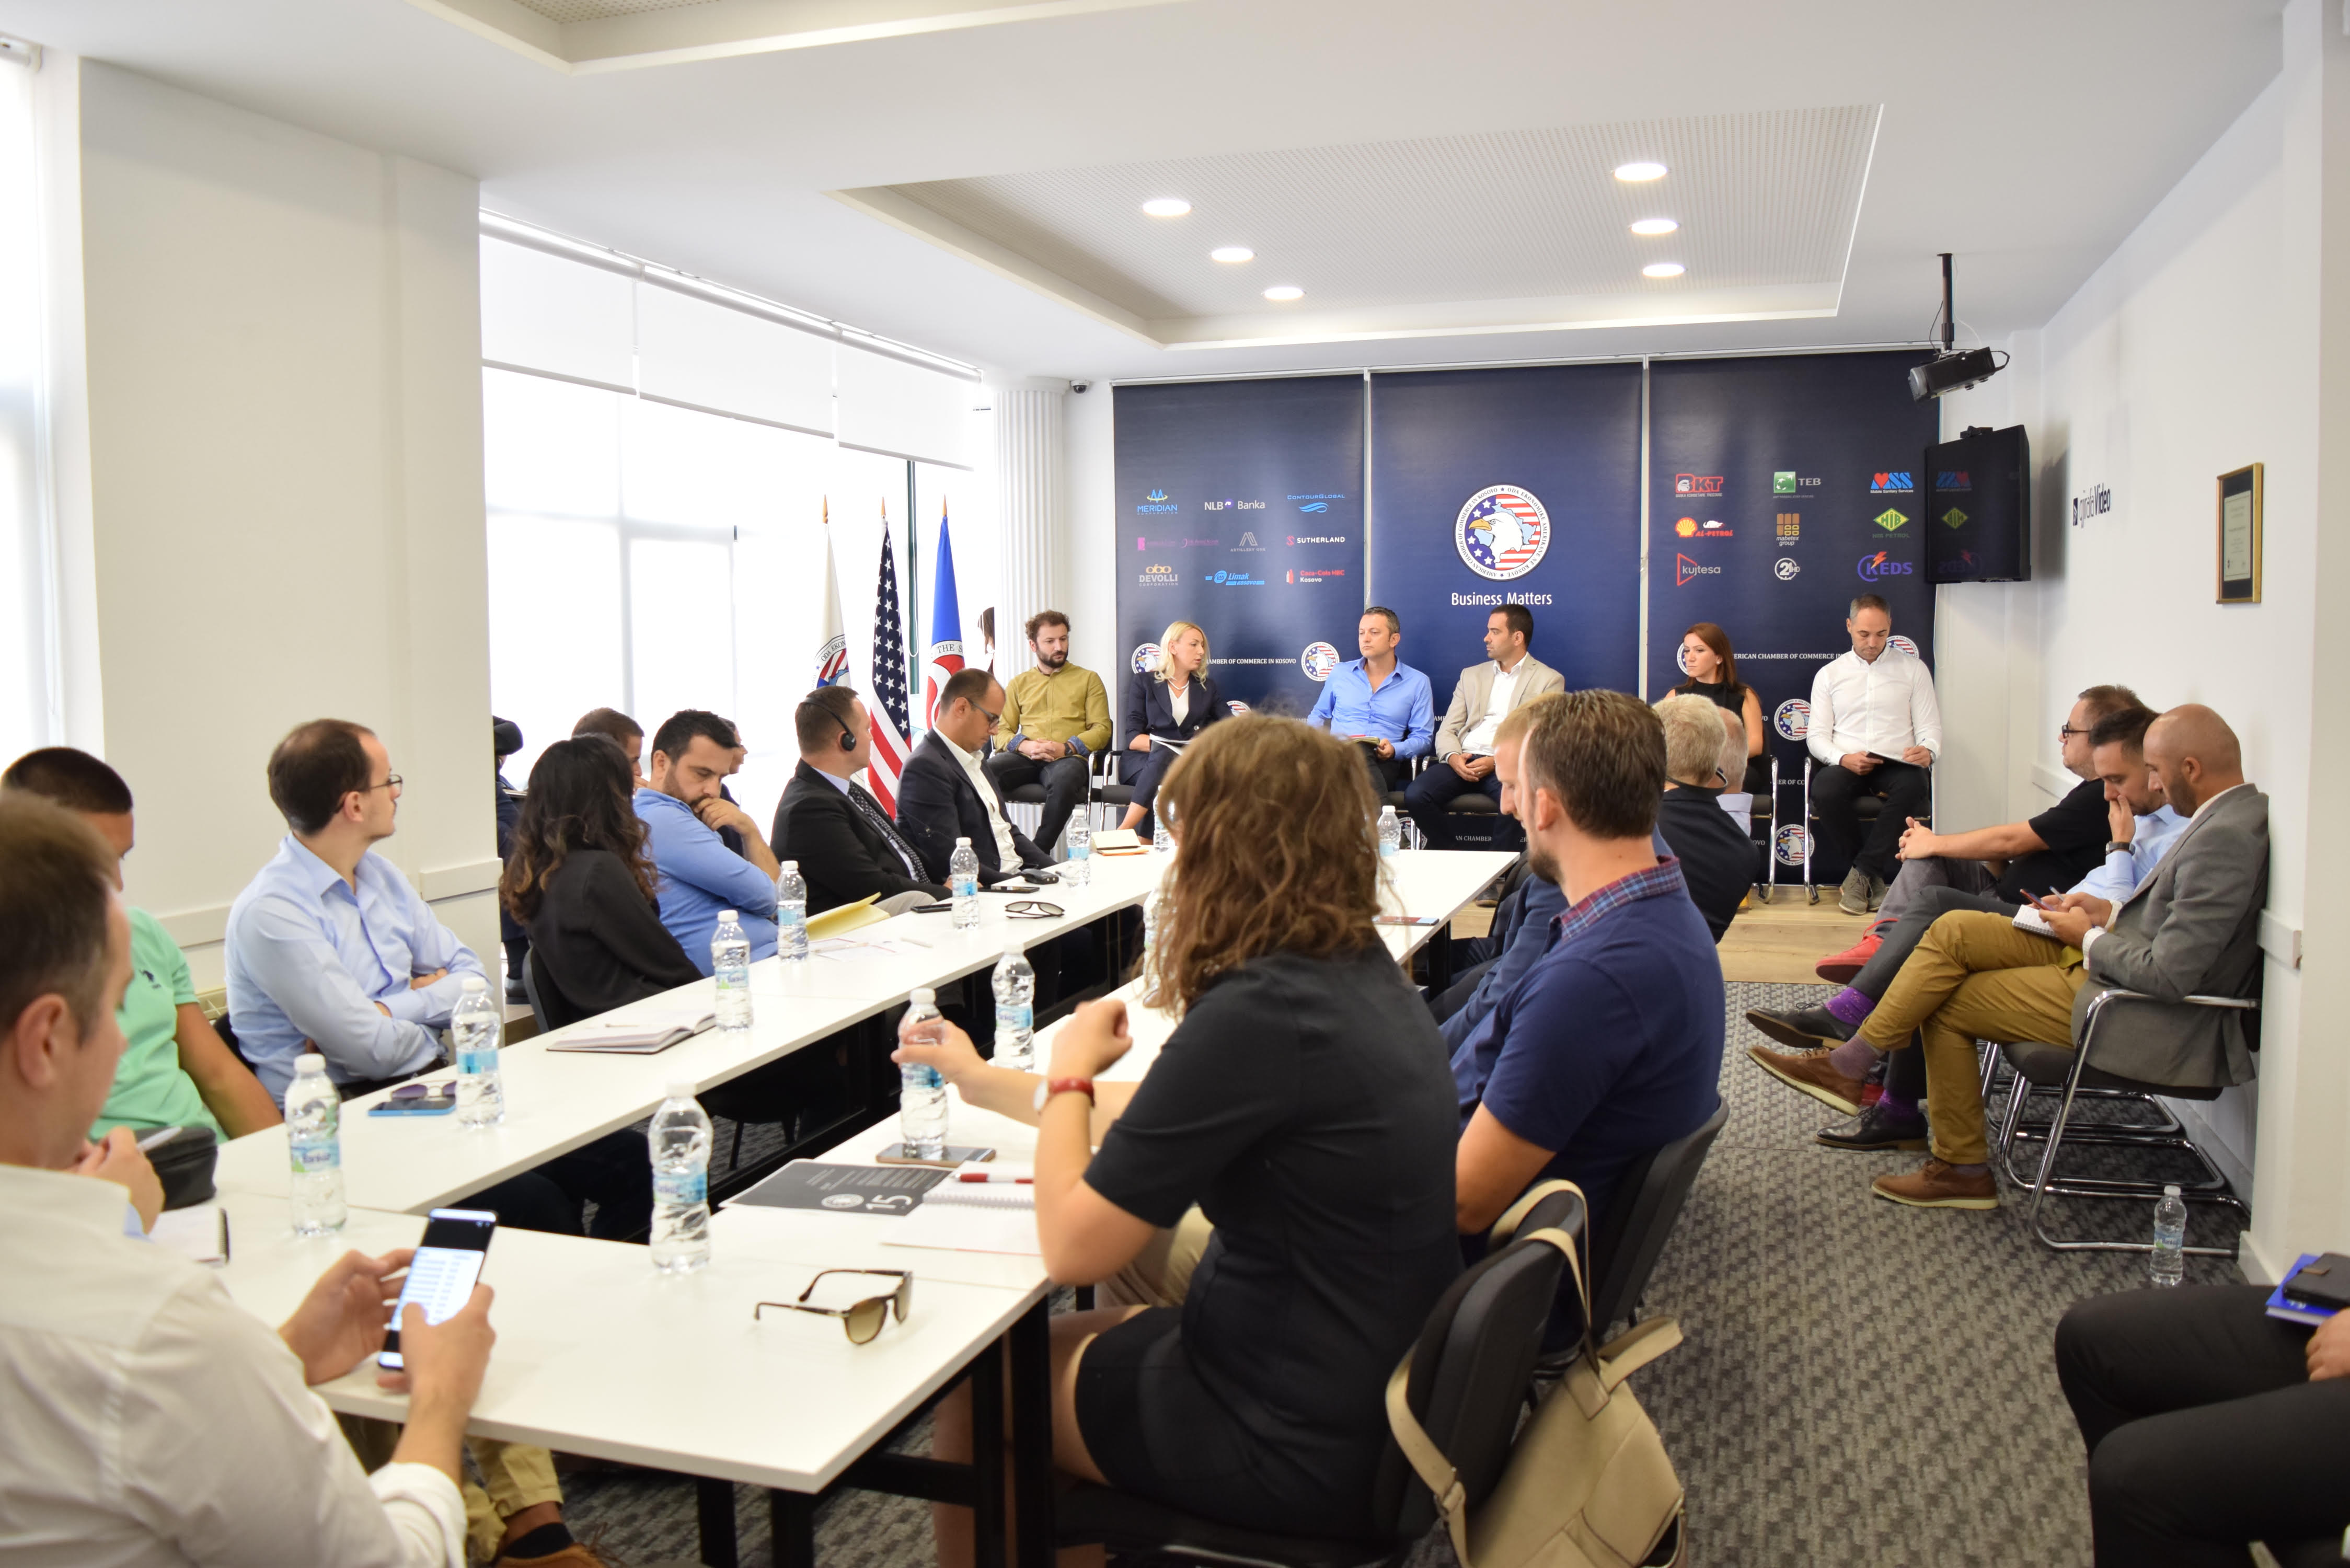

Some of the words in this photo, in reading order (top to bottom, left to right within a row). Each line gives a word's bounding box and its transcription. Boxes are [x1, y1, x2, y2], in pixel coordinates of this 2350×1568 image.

[1676, 474, 1723, 493] BKT
[1477, 488, 1497, 499] KOSOVO
[1204, 501, 1224, 511] NLB
[1238, 500, 1265, 509] Banka
[1683, 566, 1721, 576] kujtesa
[1867, 562, 1913, 575] KEDS
[1452, 592, 1502, 605] Business
[1507, 592, 1552, 605] Matters
[937, 644, 954, 653] THE
